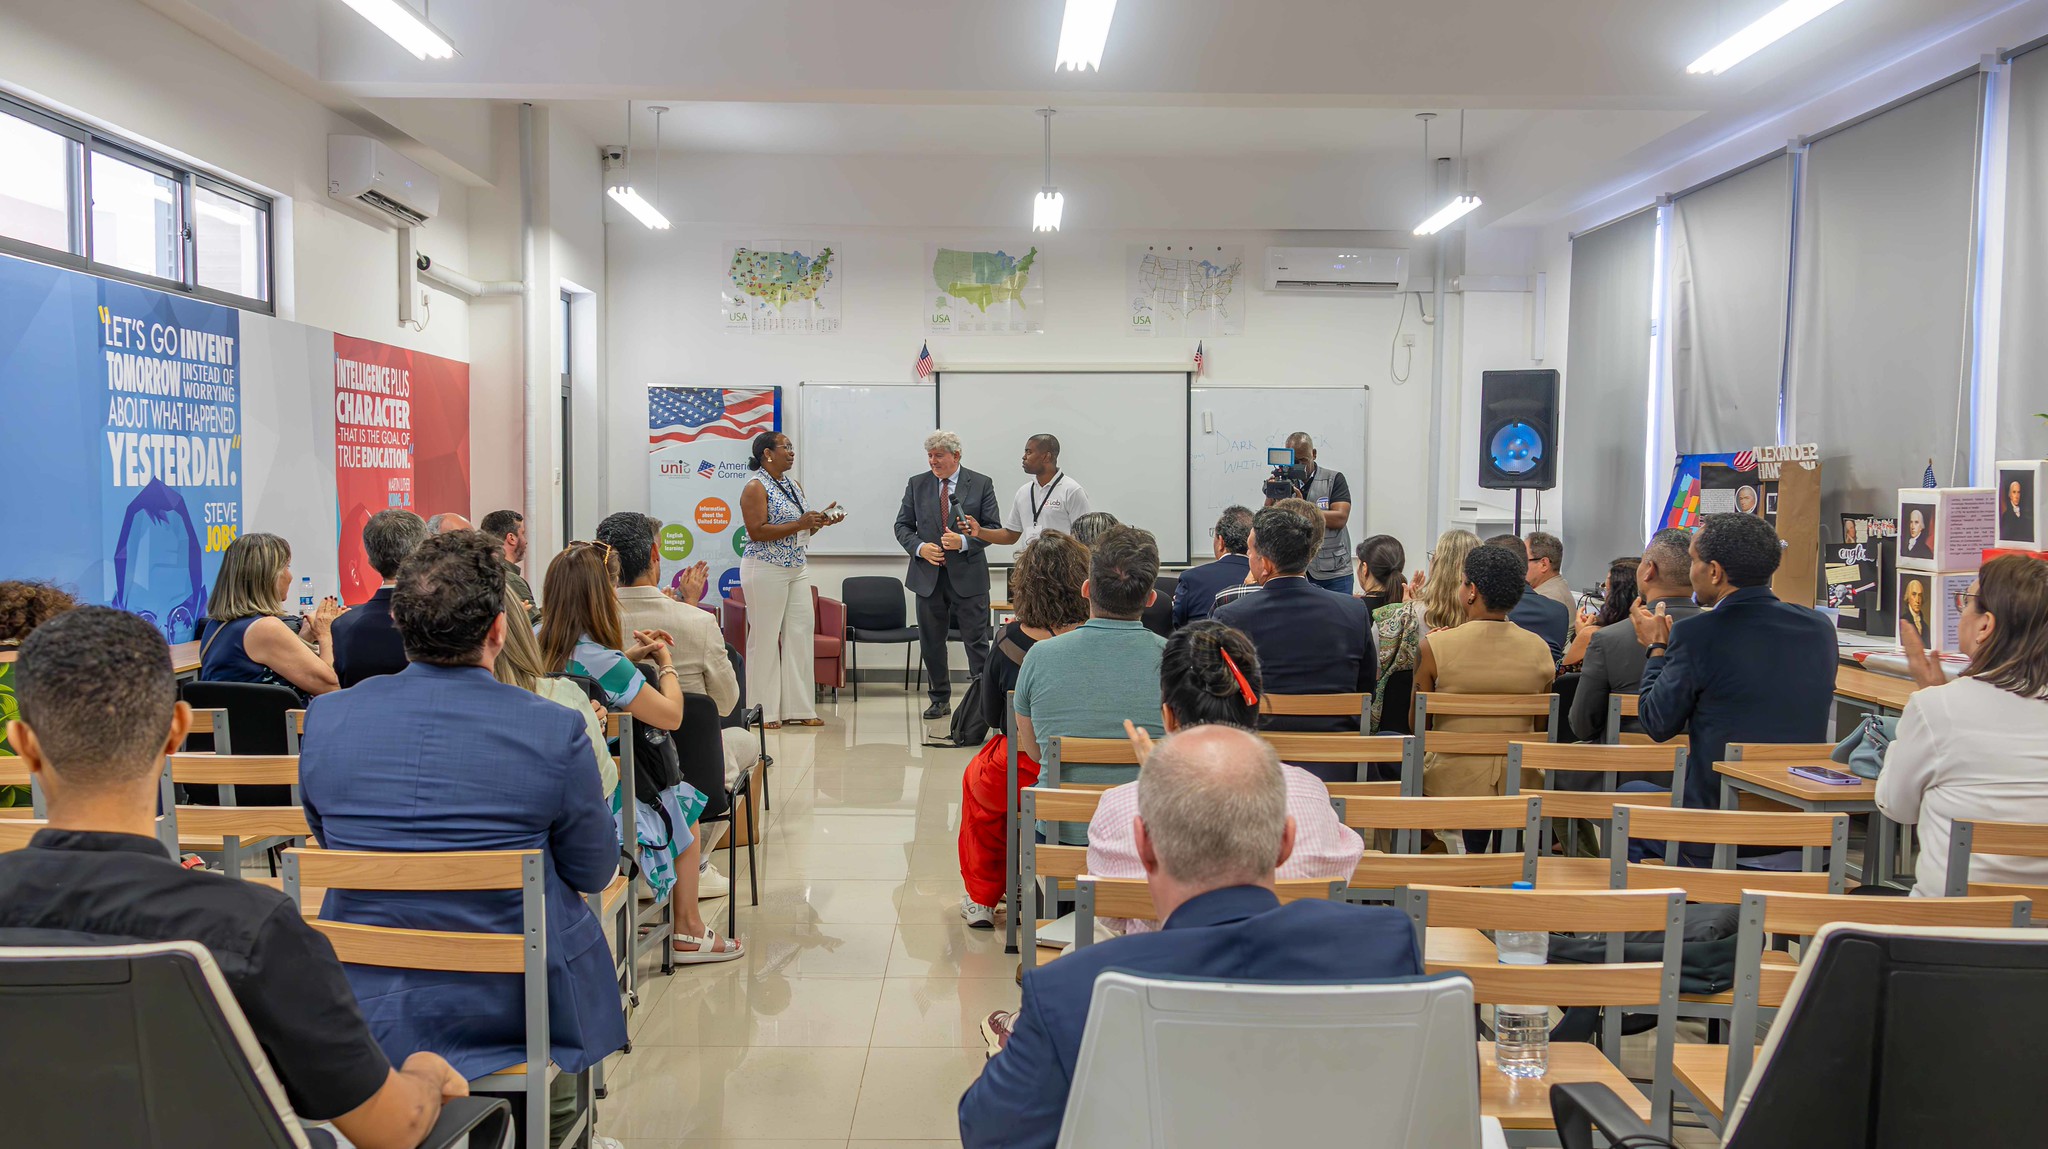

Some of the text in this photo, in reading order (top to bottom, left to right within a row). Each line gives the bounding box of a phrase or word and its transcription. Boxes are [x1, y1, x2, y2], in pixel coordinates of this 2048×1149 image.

[729, 312, 748, 322] USA
[932, 314, 951, 323] USA
[1132, 315, 1152, 325] USA
[151, 323, 178, 356] GO
[180, 328, 234, 366] INVENT
[106, 350, 182, 398] TOMORROW
[182, 362, 235, 386] INSTEAD OF
[390, 367, 410, 398] PLUS
[182, 381, 235, 403] WORRYING
[107, 395, 236, 434] ABOUT WHAT HAPPENED
[336, 391, 411, 430] CHARACTER
[359, 428, 366, 443] IS
[367, 429, 380, 444] THE
[381, 430, 400, 445] GOAL
[401, 432, 411, 446] OF
[337, 445, 361, 468] TRUE
[1751, 443, 1819, 463] ALEXANDER
[717, 470, 747, 479] Corner
[718, 460, 750, 471] Ameri
[204, 502, 237, 524] STEVE
